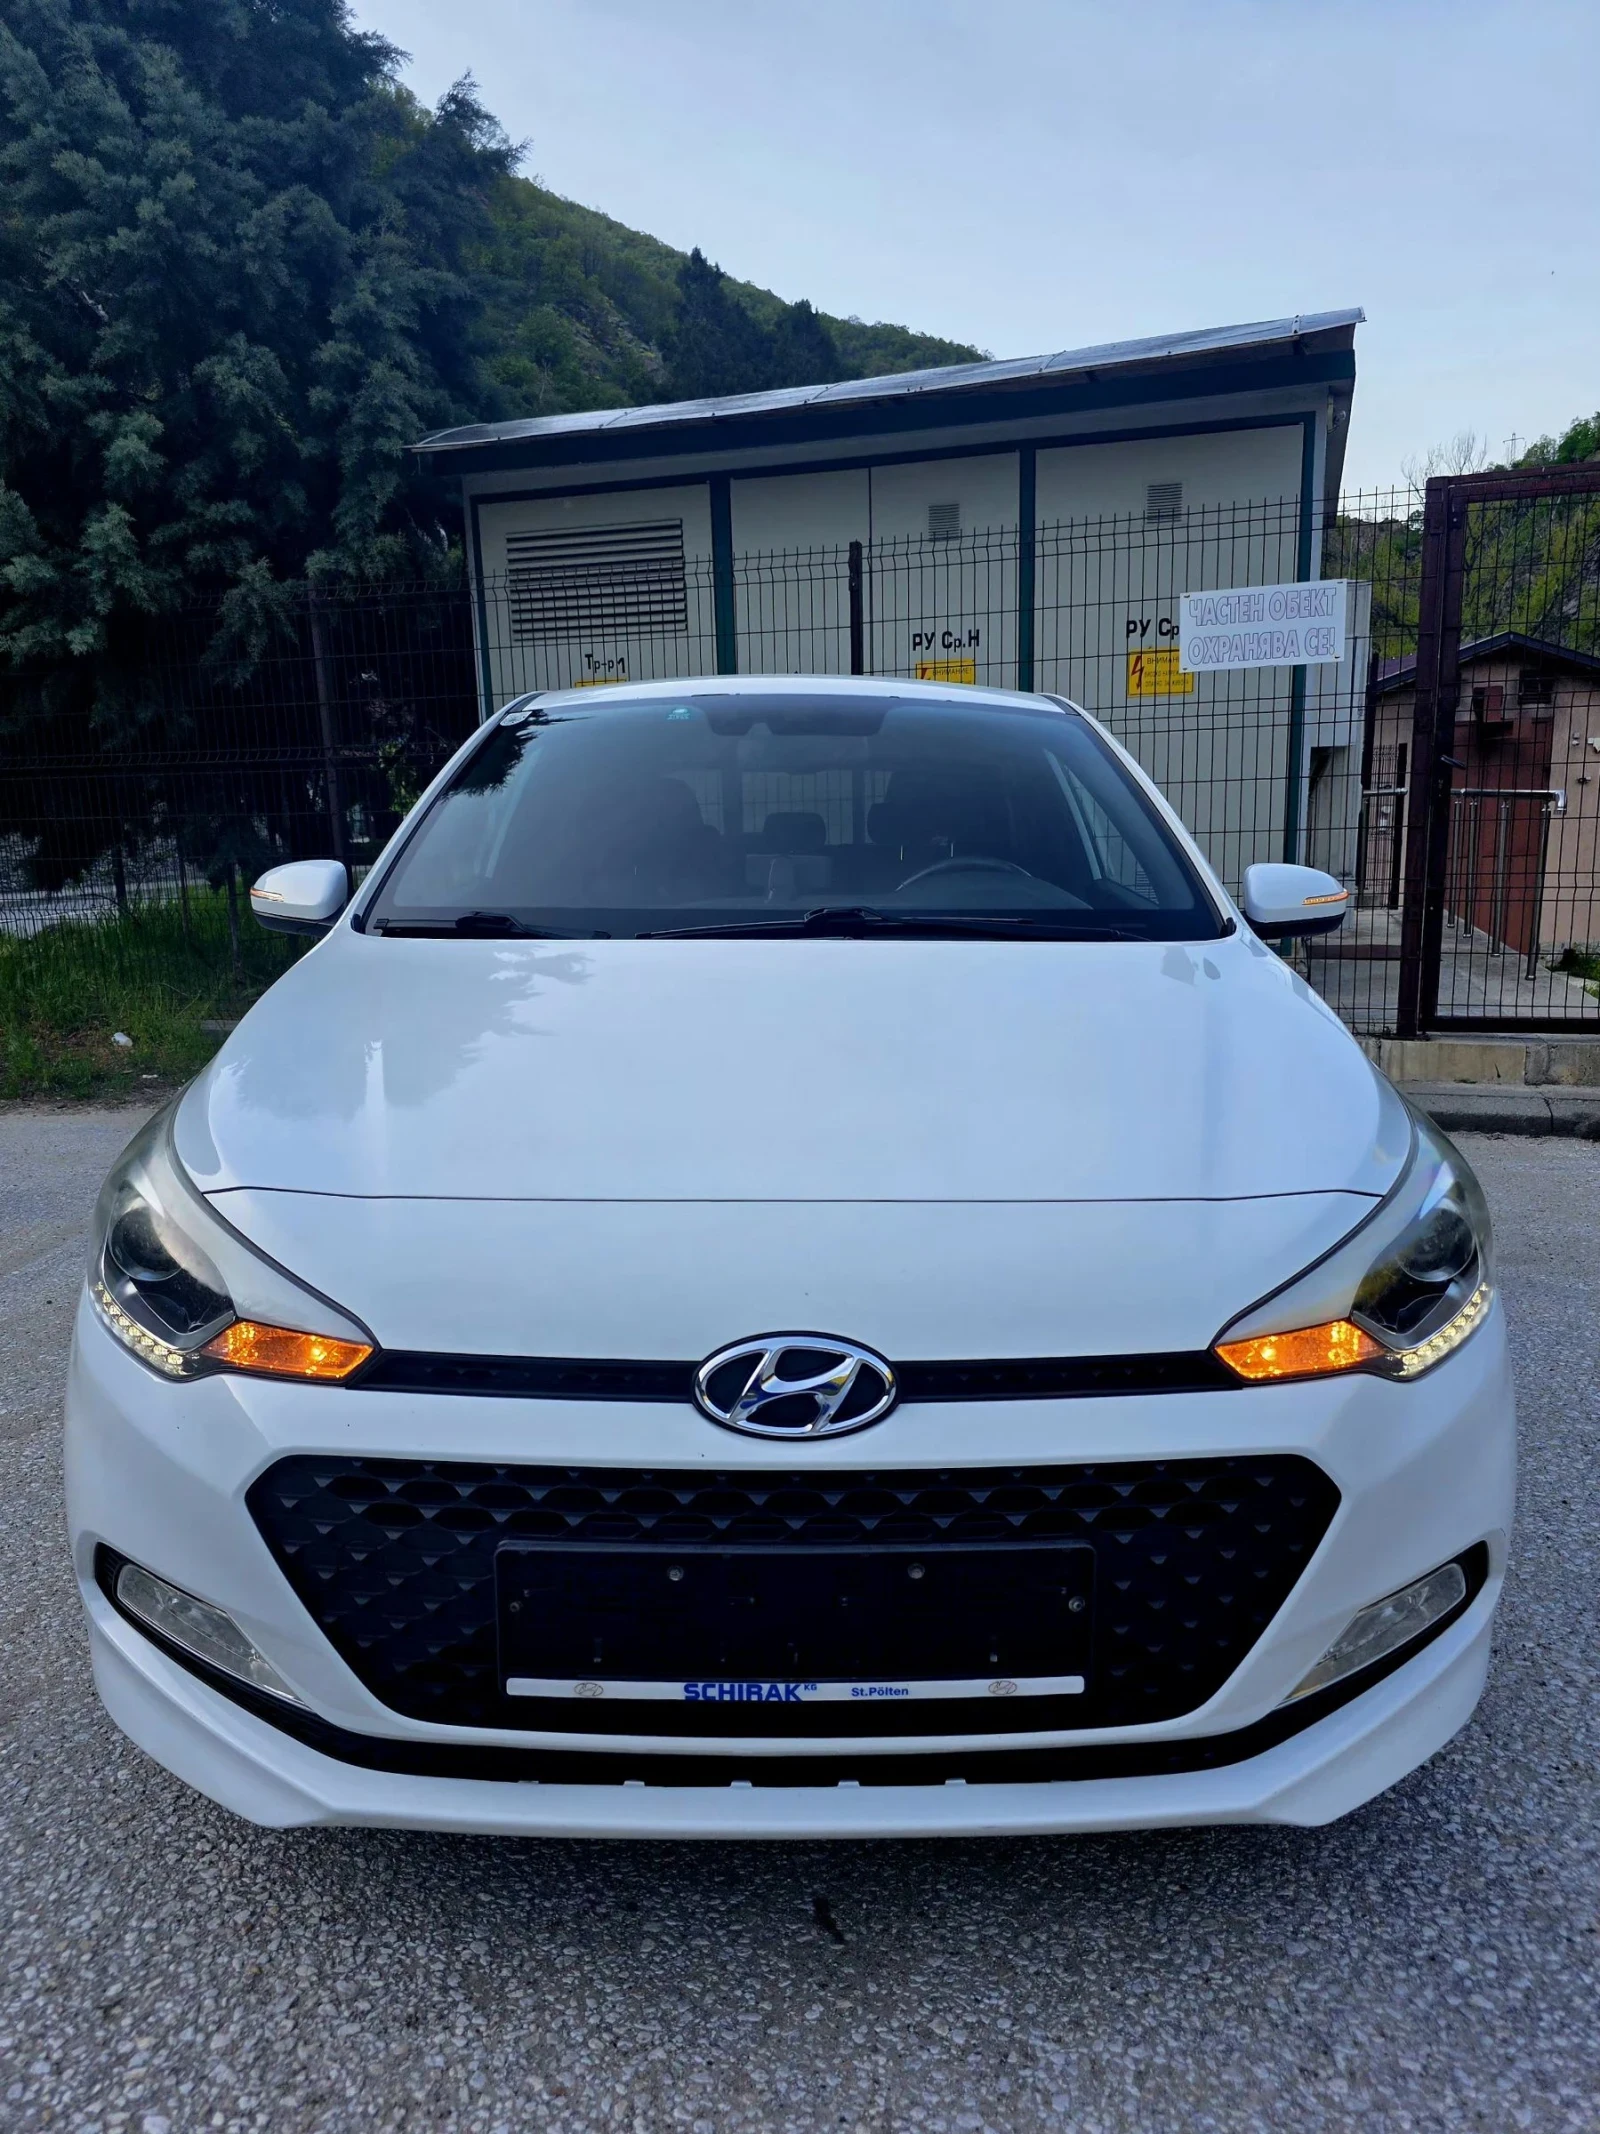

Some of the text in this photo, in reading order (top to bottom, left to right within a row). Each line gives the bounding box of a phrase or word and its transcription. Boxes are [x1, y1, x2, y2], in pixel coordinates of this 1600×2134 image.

[1189, 588, 1336, 626] ЧАСТЕН ОБЕКТ
[1126, 618, 1152, 639] РУ
[912, 632, 935, 651] РУ
[1188, 627, 1335, 665] ОХРАНЯВА СЕ!
[683, 1682, 909, 1702] SCHIRAK KG St.Pölten
